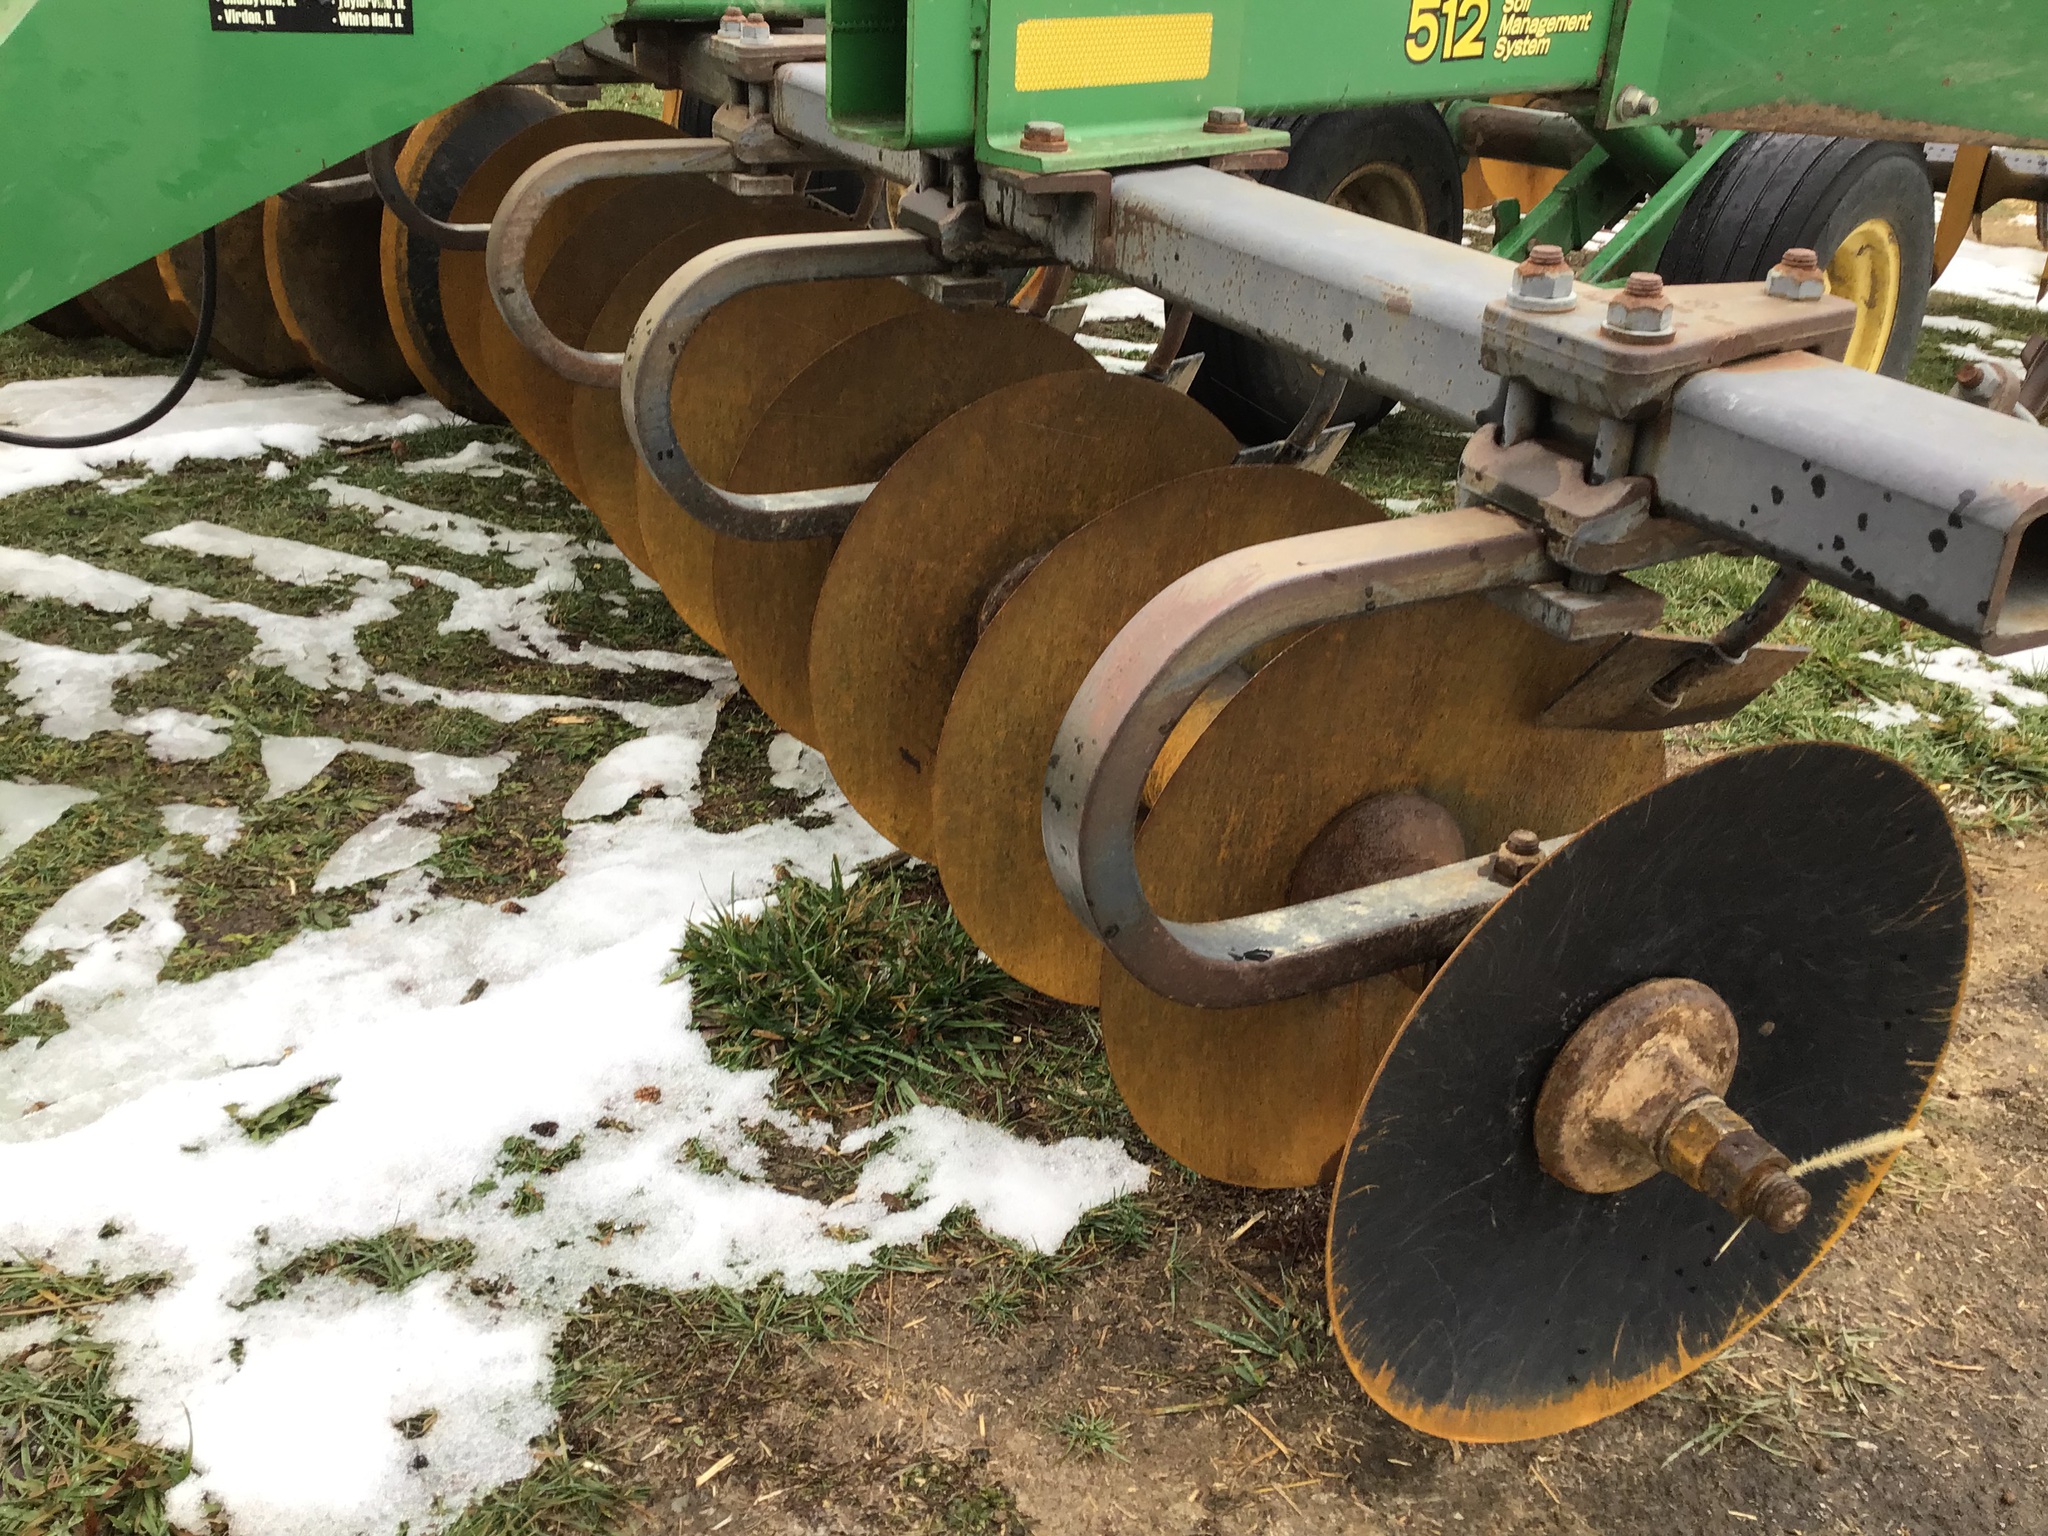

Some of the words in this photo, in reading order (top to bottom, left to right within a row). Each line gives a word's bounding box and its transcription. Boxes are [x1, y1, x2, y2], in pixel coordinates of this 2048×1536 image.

[265, 9, 277, 25] IL
[338, 11, 370, 27] White
[371, 12, 393, 28] Hall,
[394, 12, 405, 28] IL
[1497, 10, 1593, 38] Management
[1404, 0, 1490, 64] 512
[1493, 35, 1551, 62] System
